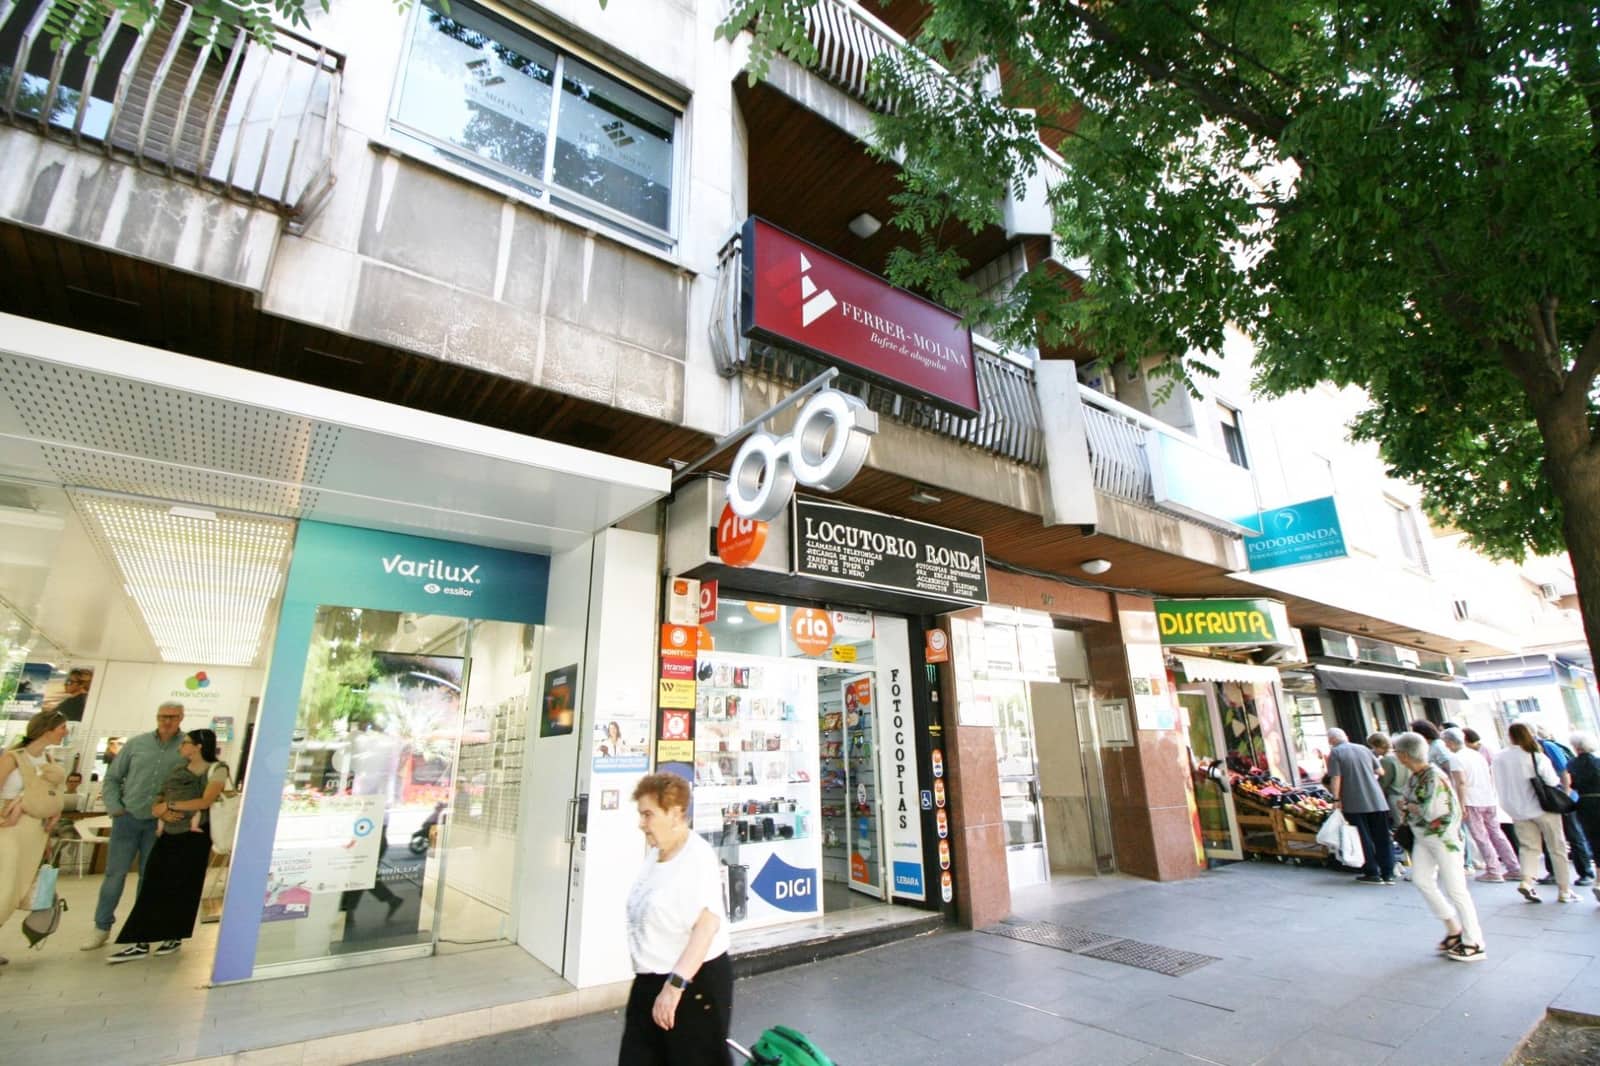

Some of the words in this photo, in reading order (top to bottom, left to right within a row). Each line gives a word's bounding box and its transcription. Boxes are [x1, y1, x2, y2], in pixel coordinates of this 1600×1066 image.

[805, 517, 917, 559] LOCUTORIO
[925, 544, 982, 573] RONDA
[1248, 527, 1338, 553] PODORONDA
[443, 586, 473, 597] essilor
[796, 609, 828, 637] ria
[1159, 611, 1273, 640] DISFRUTA
[890, 669, 907, 829] FOTOCOPIAS
[775, 877, 811, 899] DIGI
